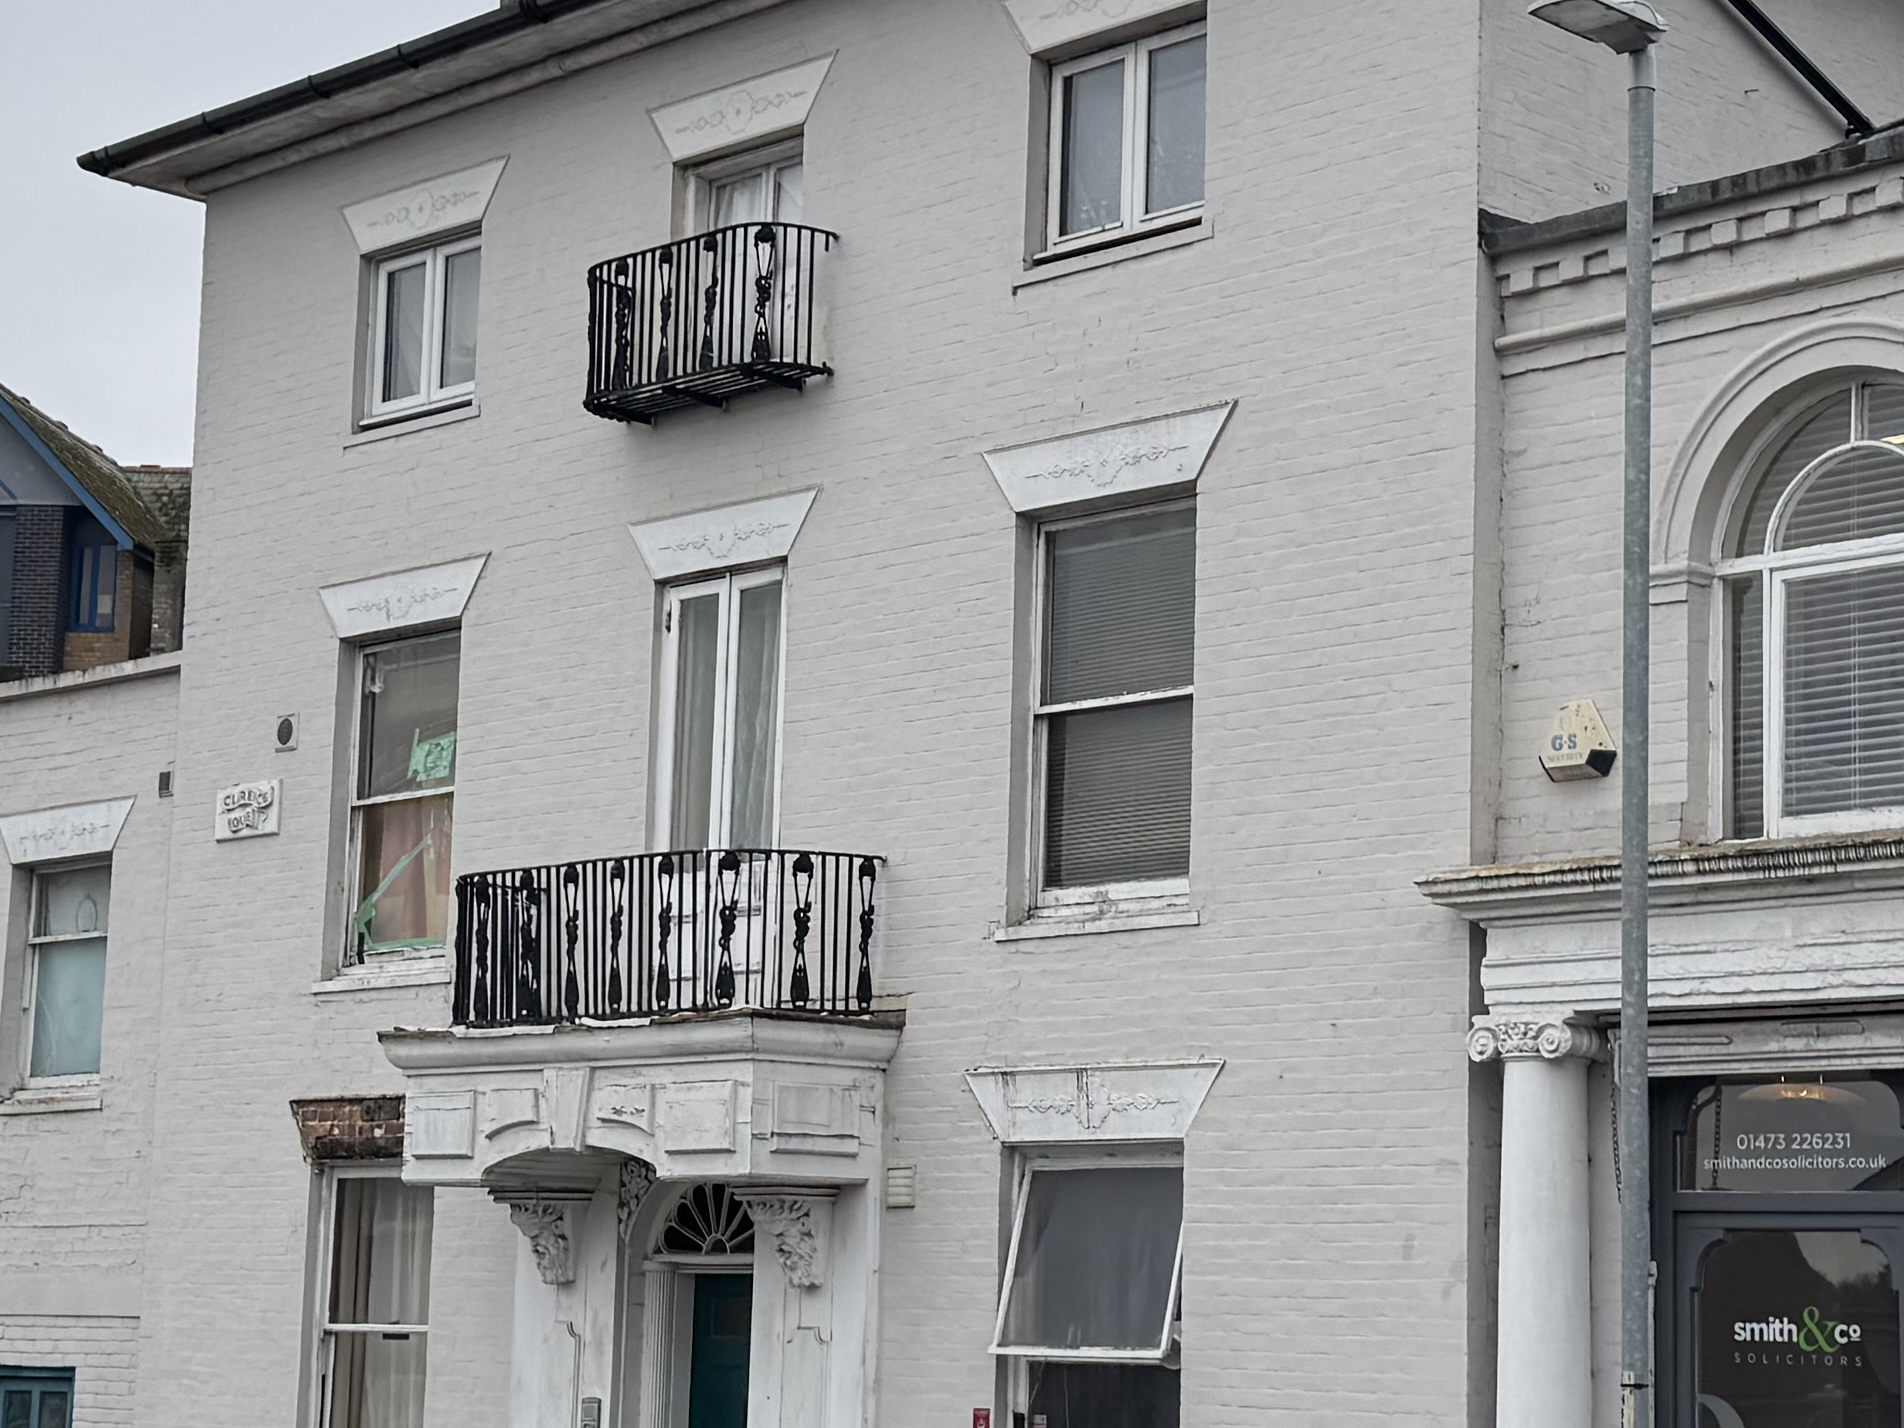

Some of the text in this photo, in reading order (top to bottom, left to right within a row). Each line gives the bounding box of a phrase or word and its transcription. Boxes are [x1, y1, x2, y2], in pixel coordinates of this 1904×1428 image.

[1736, 1132, 1852, 1150] 01473 226231
[1703, 1154, 1888, 1170] smithandcosolicitors.co.uk
[1733, 1351, 1863, 1367] SOLICITORS
